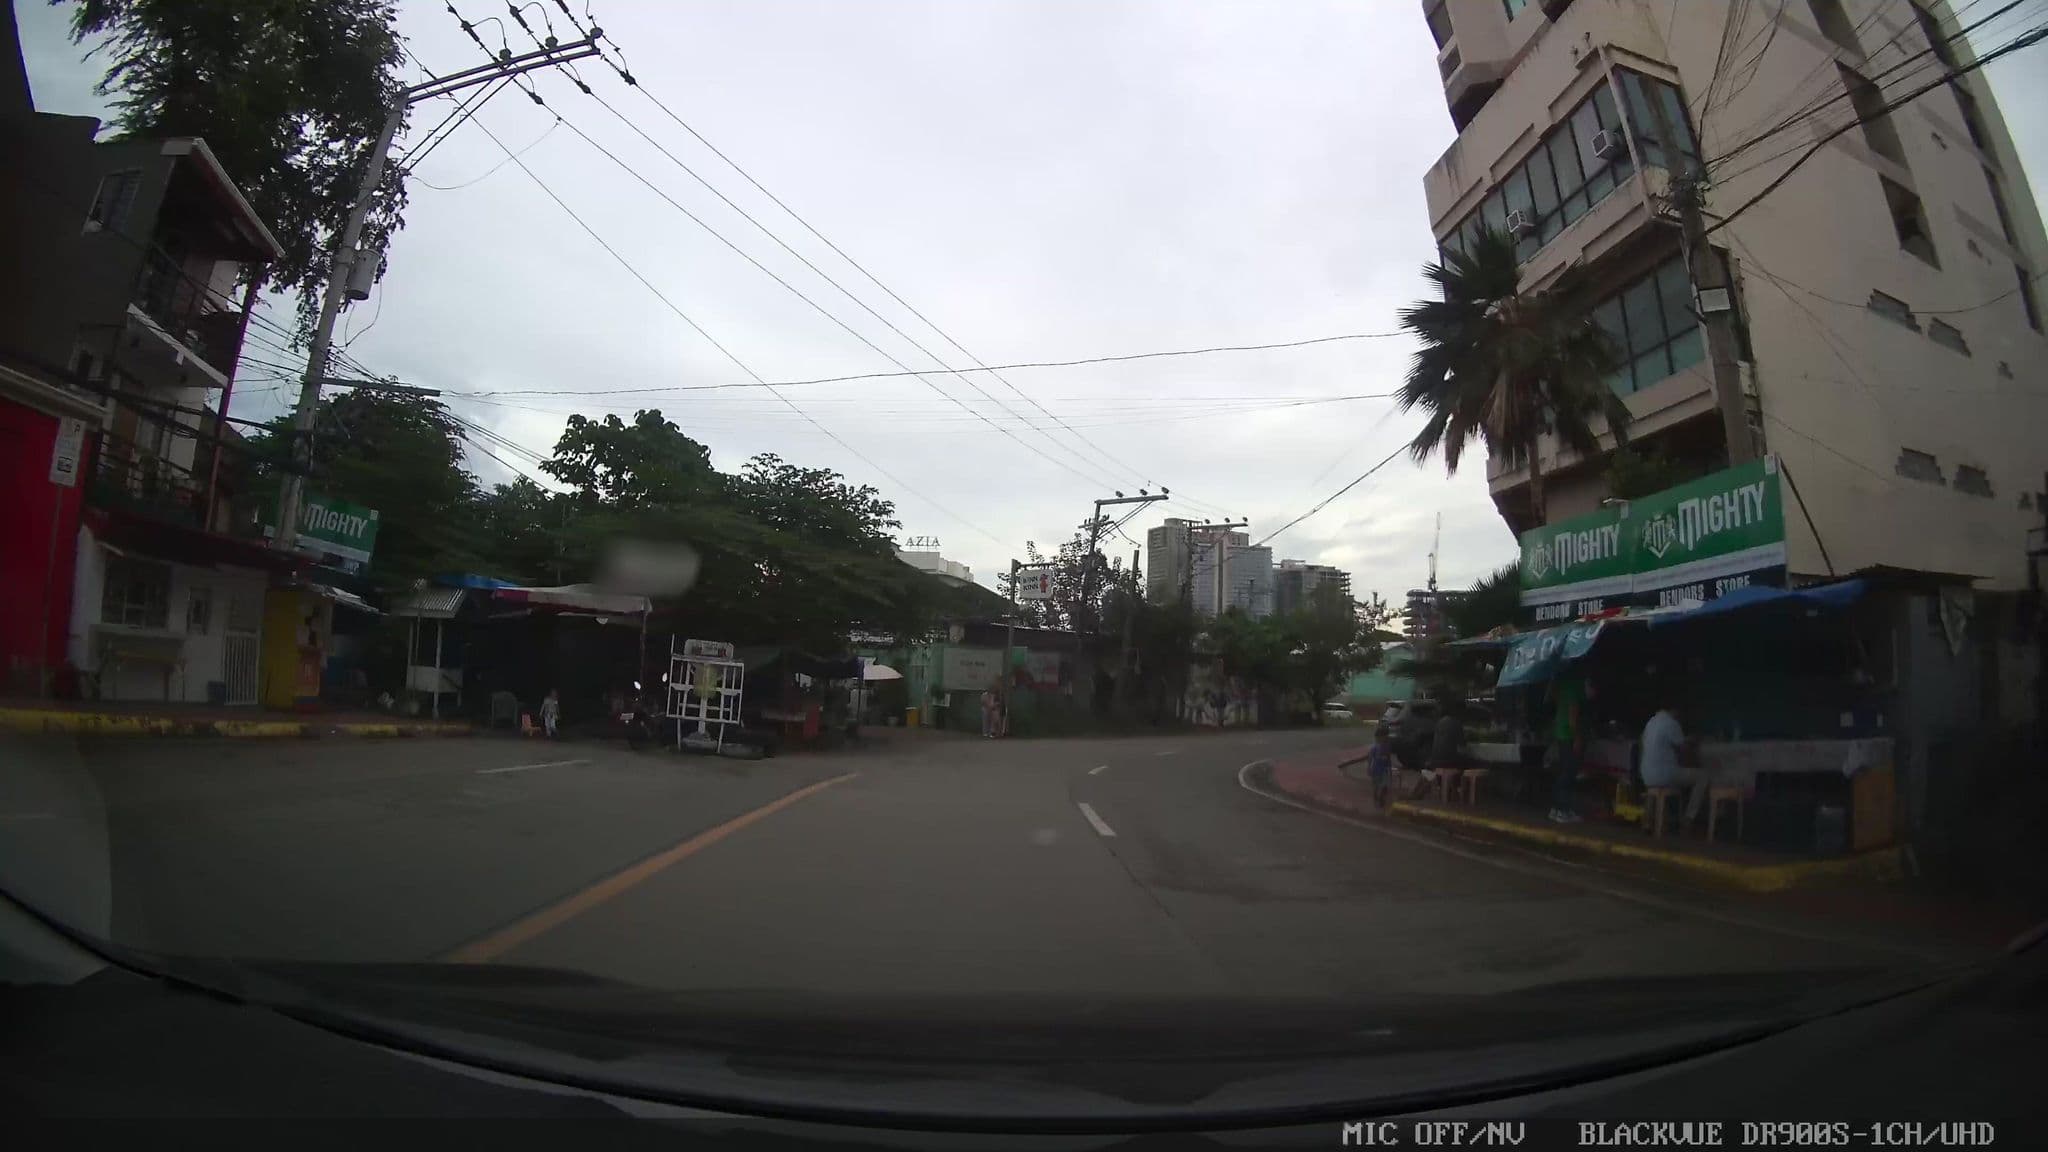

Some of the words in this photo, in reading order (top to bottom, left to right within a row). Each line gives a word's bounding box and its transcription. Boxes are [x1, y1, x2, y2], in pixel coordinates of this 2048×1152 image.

[304, 503, 368, 538] MIGHTY
[1677, 481, 1765, 551] MIGHTY
[905, 536, 941, 547] AZIA
[1554, 524, 1620, 575] MIGHTY
